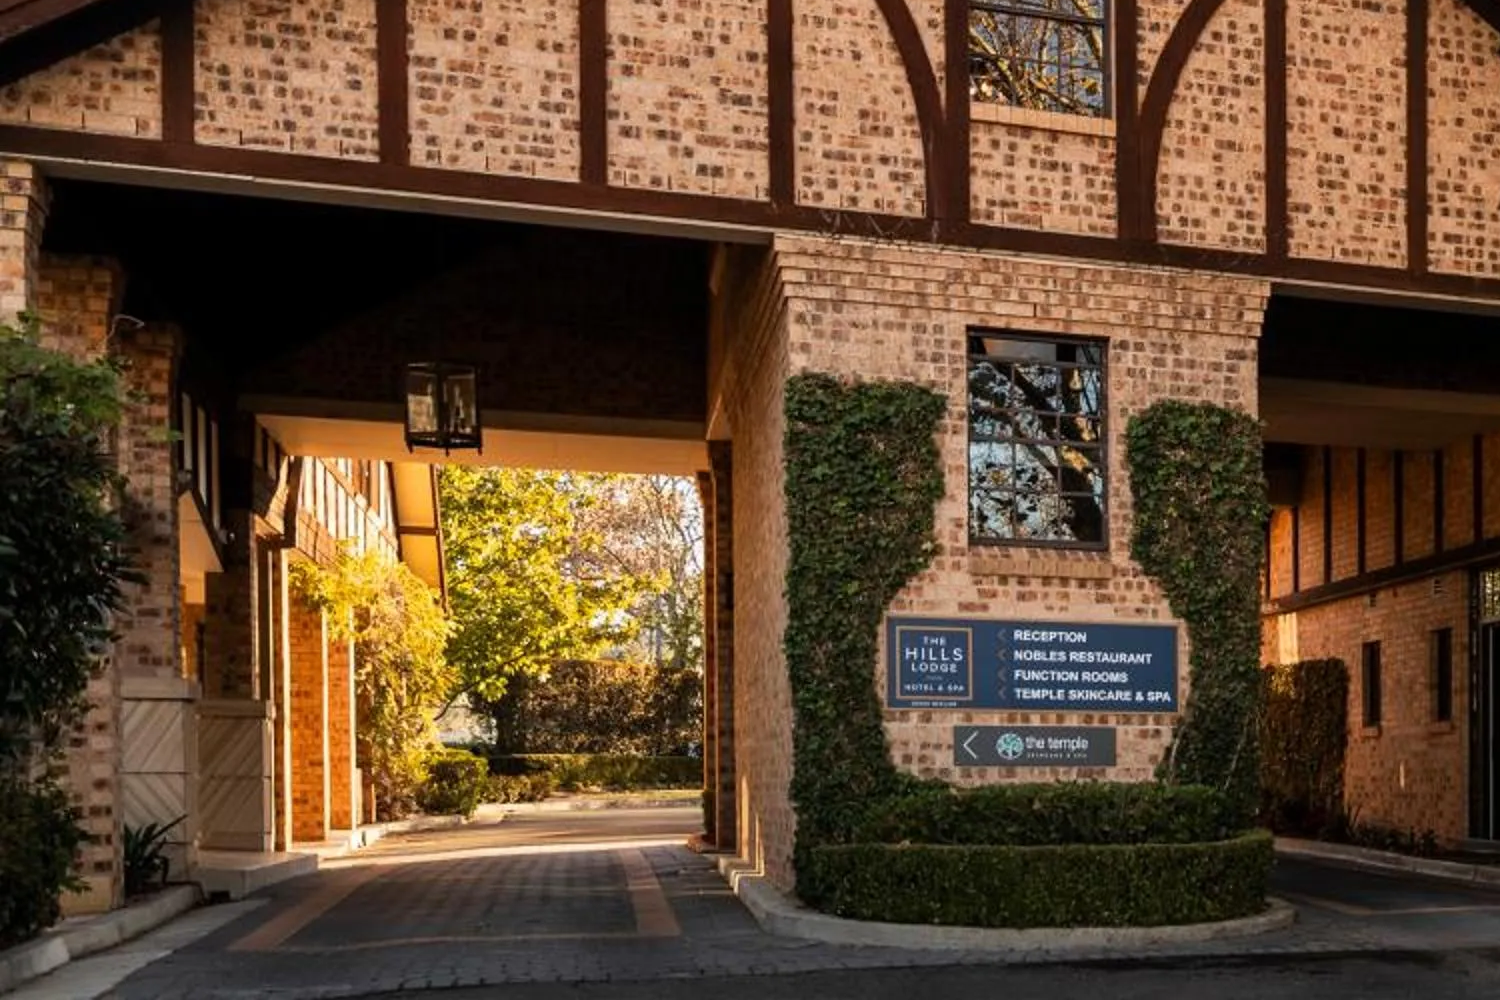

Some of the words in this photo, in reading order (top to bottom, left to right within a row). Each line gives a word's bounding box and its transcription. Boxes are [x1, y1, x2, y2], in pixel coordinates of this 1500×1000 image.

[923, 636, 947, 646] THE
[1014, 630, 1087, 643] RECEPTION
[905, 647, 963, 661] HILLS
[1014, 650, 1066, 662] NOBLES
[1069, 651, 1153, 665] RESTAURANT
[911, 662, 957, 673] LODGE
[1013, 669, 1079, 682] FUNCTION
[1081, 671, 1129, 683] ROOMS
[1014, 688, 1065, 699] TEMPLE
[1067, 688, 1133, 701] SKINCARE
[1135, 690, 1145, 702] &
[1147, 691, 1171, 702] SPA
[1025, 736, 1045, 749] the
[1047, 736, 1089, 752] temple
